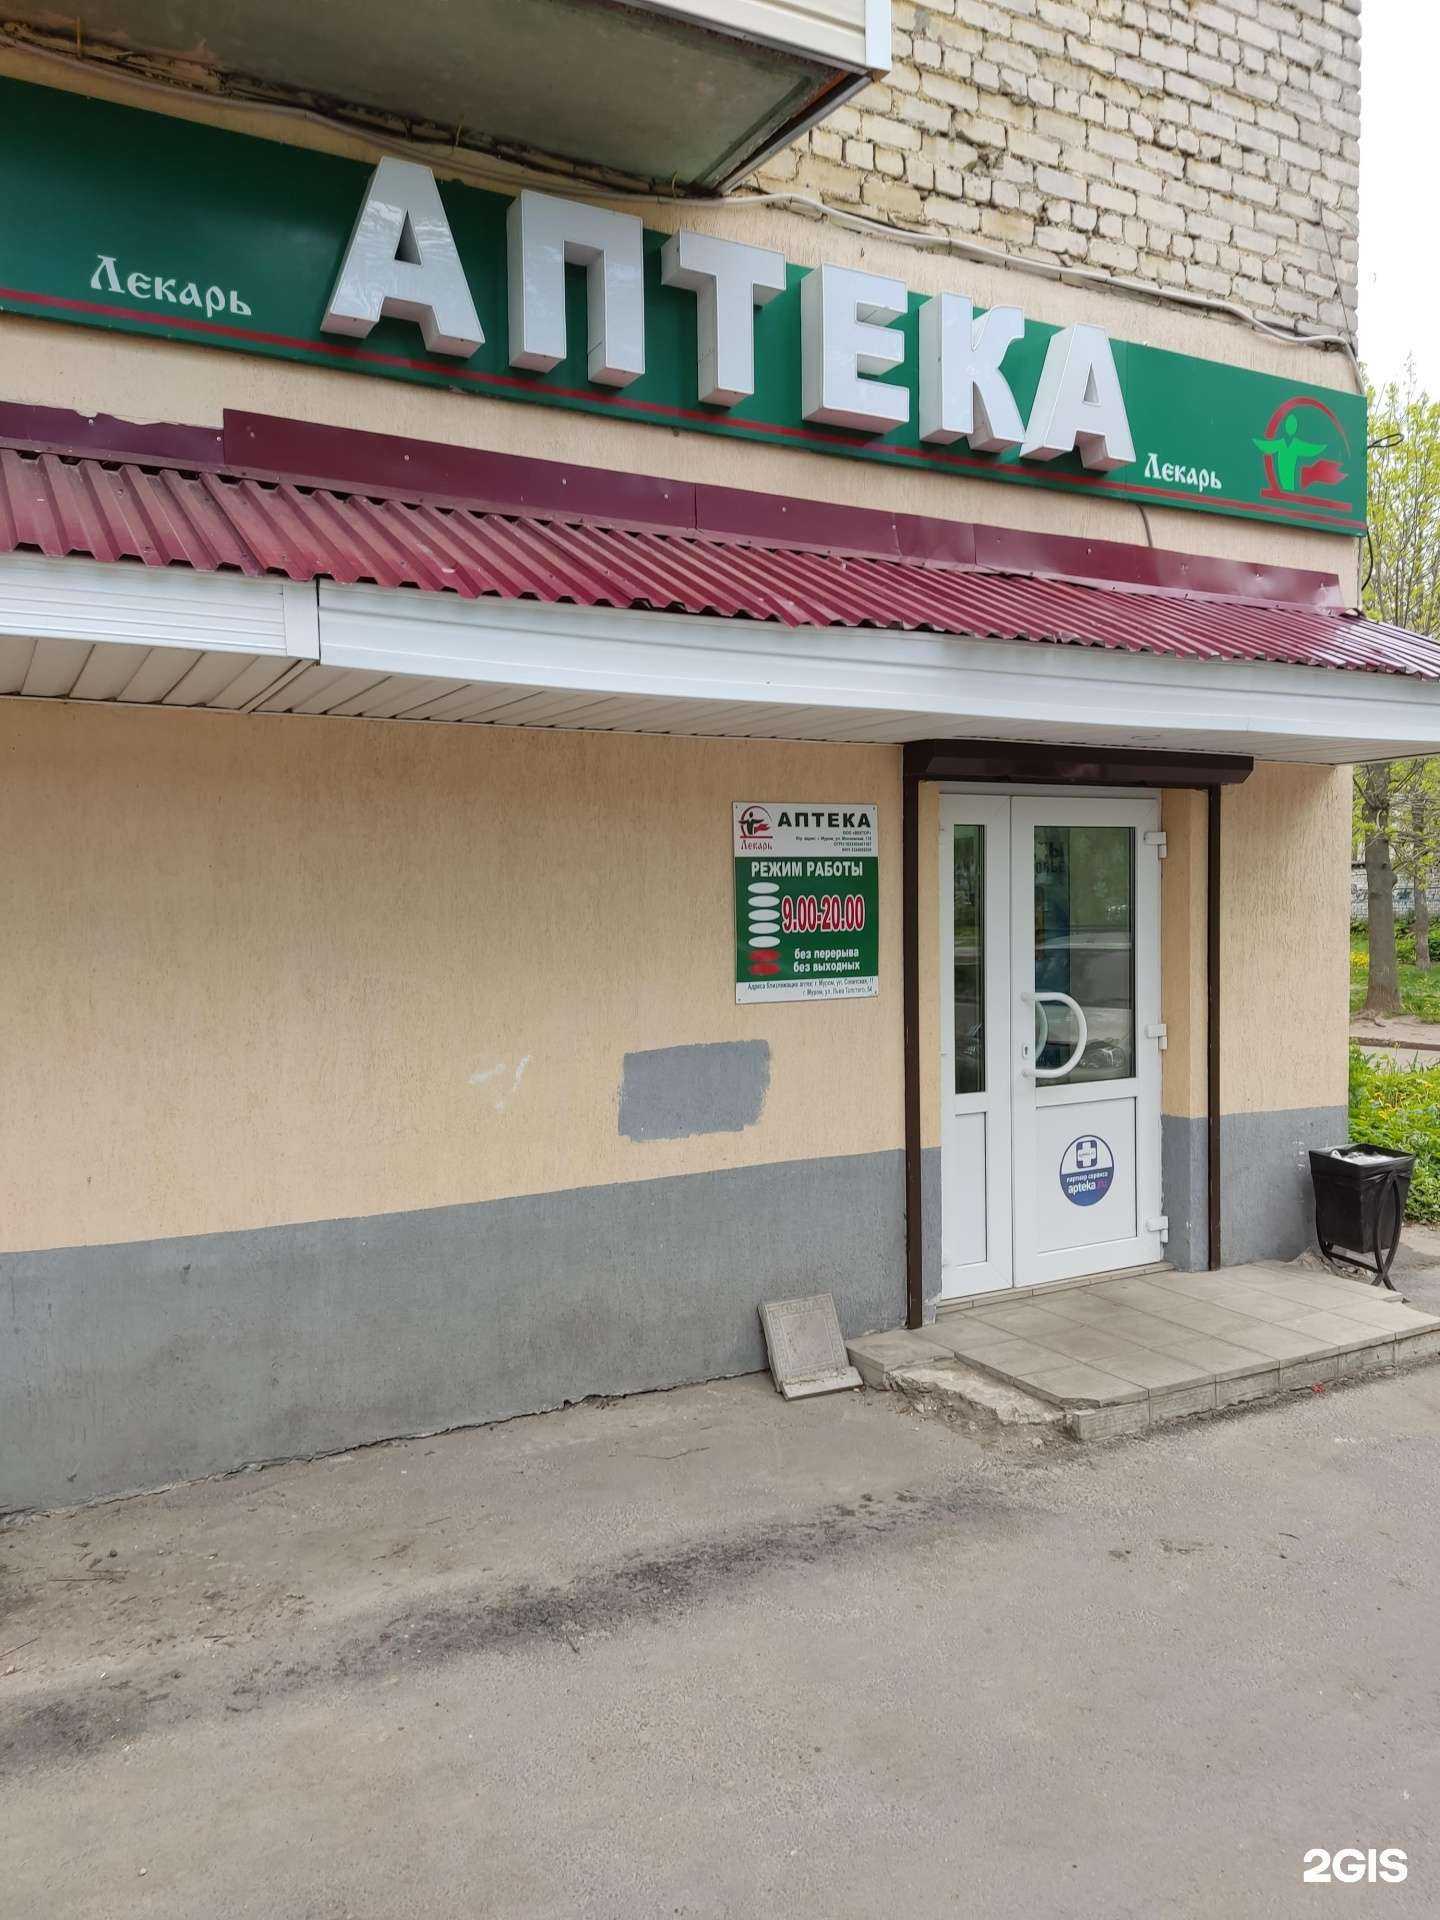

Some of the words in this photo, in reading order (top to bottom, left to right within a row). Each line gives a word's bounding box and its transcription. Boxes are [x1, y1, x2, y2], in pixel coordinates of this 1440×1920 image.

[91, 254, 252, 318] Лекарь
[321, 156, 1136, 472] АПТЕКА
[1144, 452, 1222, 492] Лекарь
[777, 812, 871, 828] АПТЕКА
[740, 839, 773, 851] Лекарь
[751, 861, 803, 878] РЕЖИМ
[806, 861, 863, 877] РАБОТЫ
[794, 947, 812, 960] без
[813, 948, 860, 961] перерыва
[793, 961, 811, 973] без
[812, 961, 861, 974] выходных
